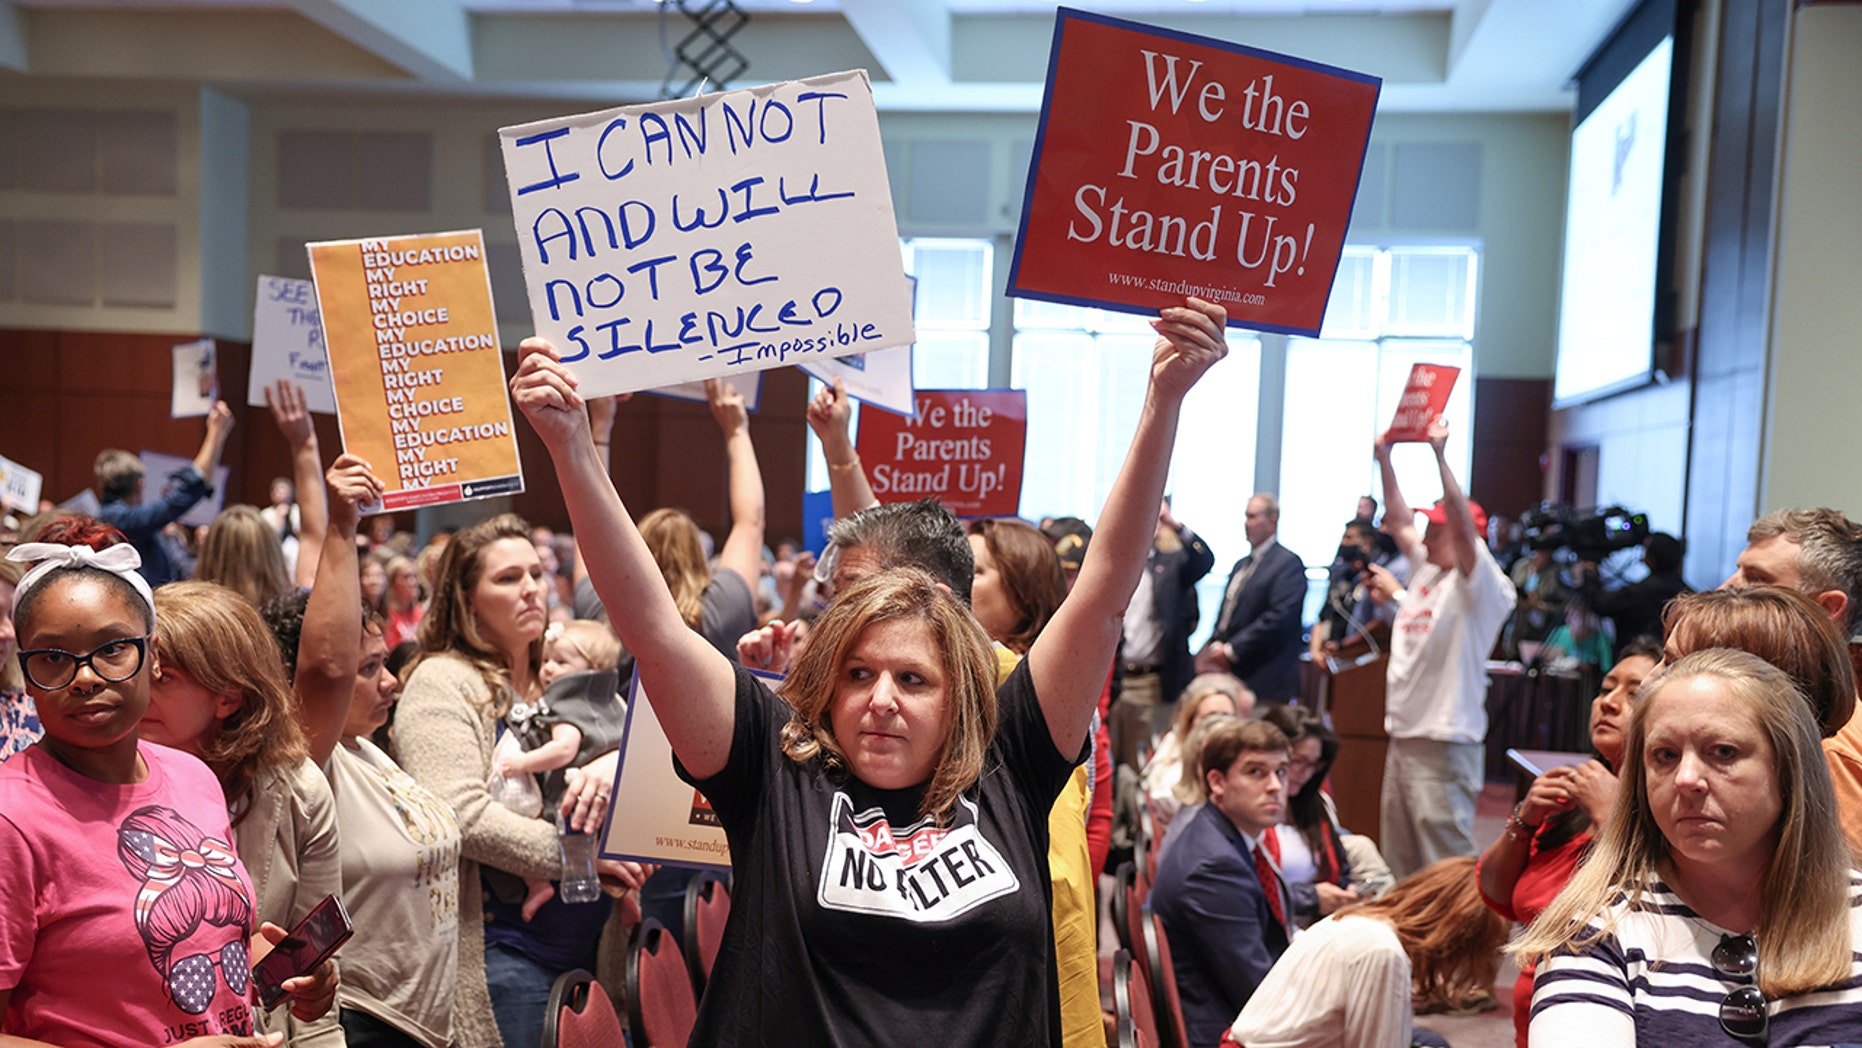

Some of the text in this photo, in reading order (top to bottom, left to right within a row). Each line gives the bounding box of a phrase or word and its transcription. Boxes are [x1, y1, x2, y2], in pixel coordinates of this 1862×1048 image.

[1140, 49, 1310, 140] We the
[516, 127, 580, 196] I
[1117, 120, 1299, 207] Parents
[533, 173, 856, 264] AND WILL
[361, 240, 389, 253] MY
[1067, 184, 1315, 288] Stand Up!
[363, 245, 479, 269] EDUCATION
[366, 267, 396, 284] MY
[545, 242, 779, 321] NOT BE
[268, 278, 309, 305] SEE
[369, 280, 428, 299] RIGHT
[1108, 272, 1266, 306] www.standupvirginia.com
[371, 298, 400, 315] MY
[374, 308, 449, 329] CHOICE
[376, 327, 406, 344] MY
[558, 287, 842, 363] SILENCED
[379, 333, 494, 359] EDUCATION
[381, 357, 411, 375] MY
[384, 369, 443, 389] RIGHT
[386, 387, 416, 405] MY
[389, 396, 464, 419] CHOICE
[953, 397, 992, 428] the
[391, 417, 421, 434] MY
[395, 421, 508, 449] EDUCATION
[397, 446, 426, 464] MY
[896, 432, 991, 461] Parents
[400, 457, 459, 478] RIGHT
[402, 477, 432, 491] MY
[872, 463, 1006, 499] Stand Up!
[655, 836, 730, 858] www.standup
[840, 847, 887, 892] NO
[164, 1020, 209, 1044] JUST
